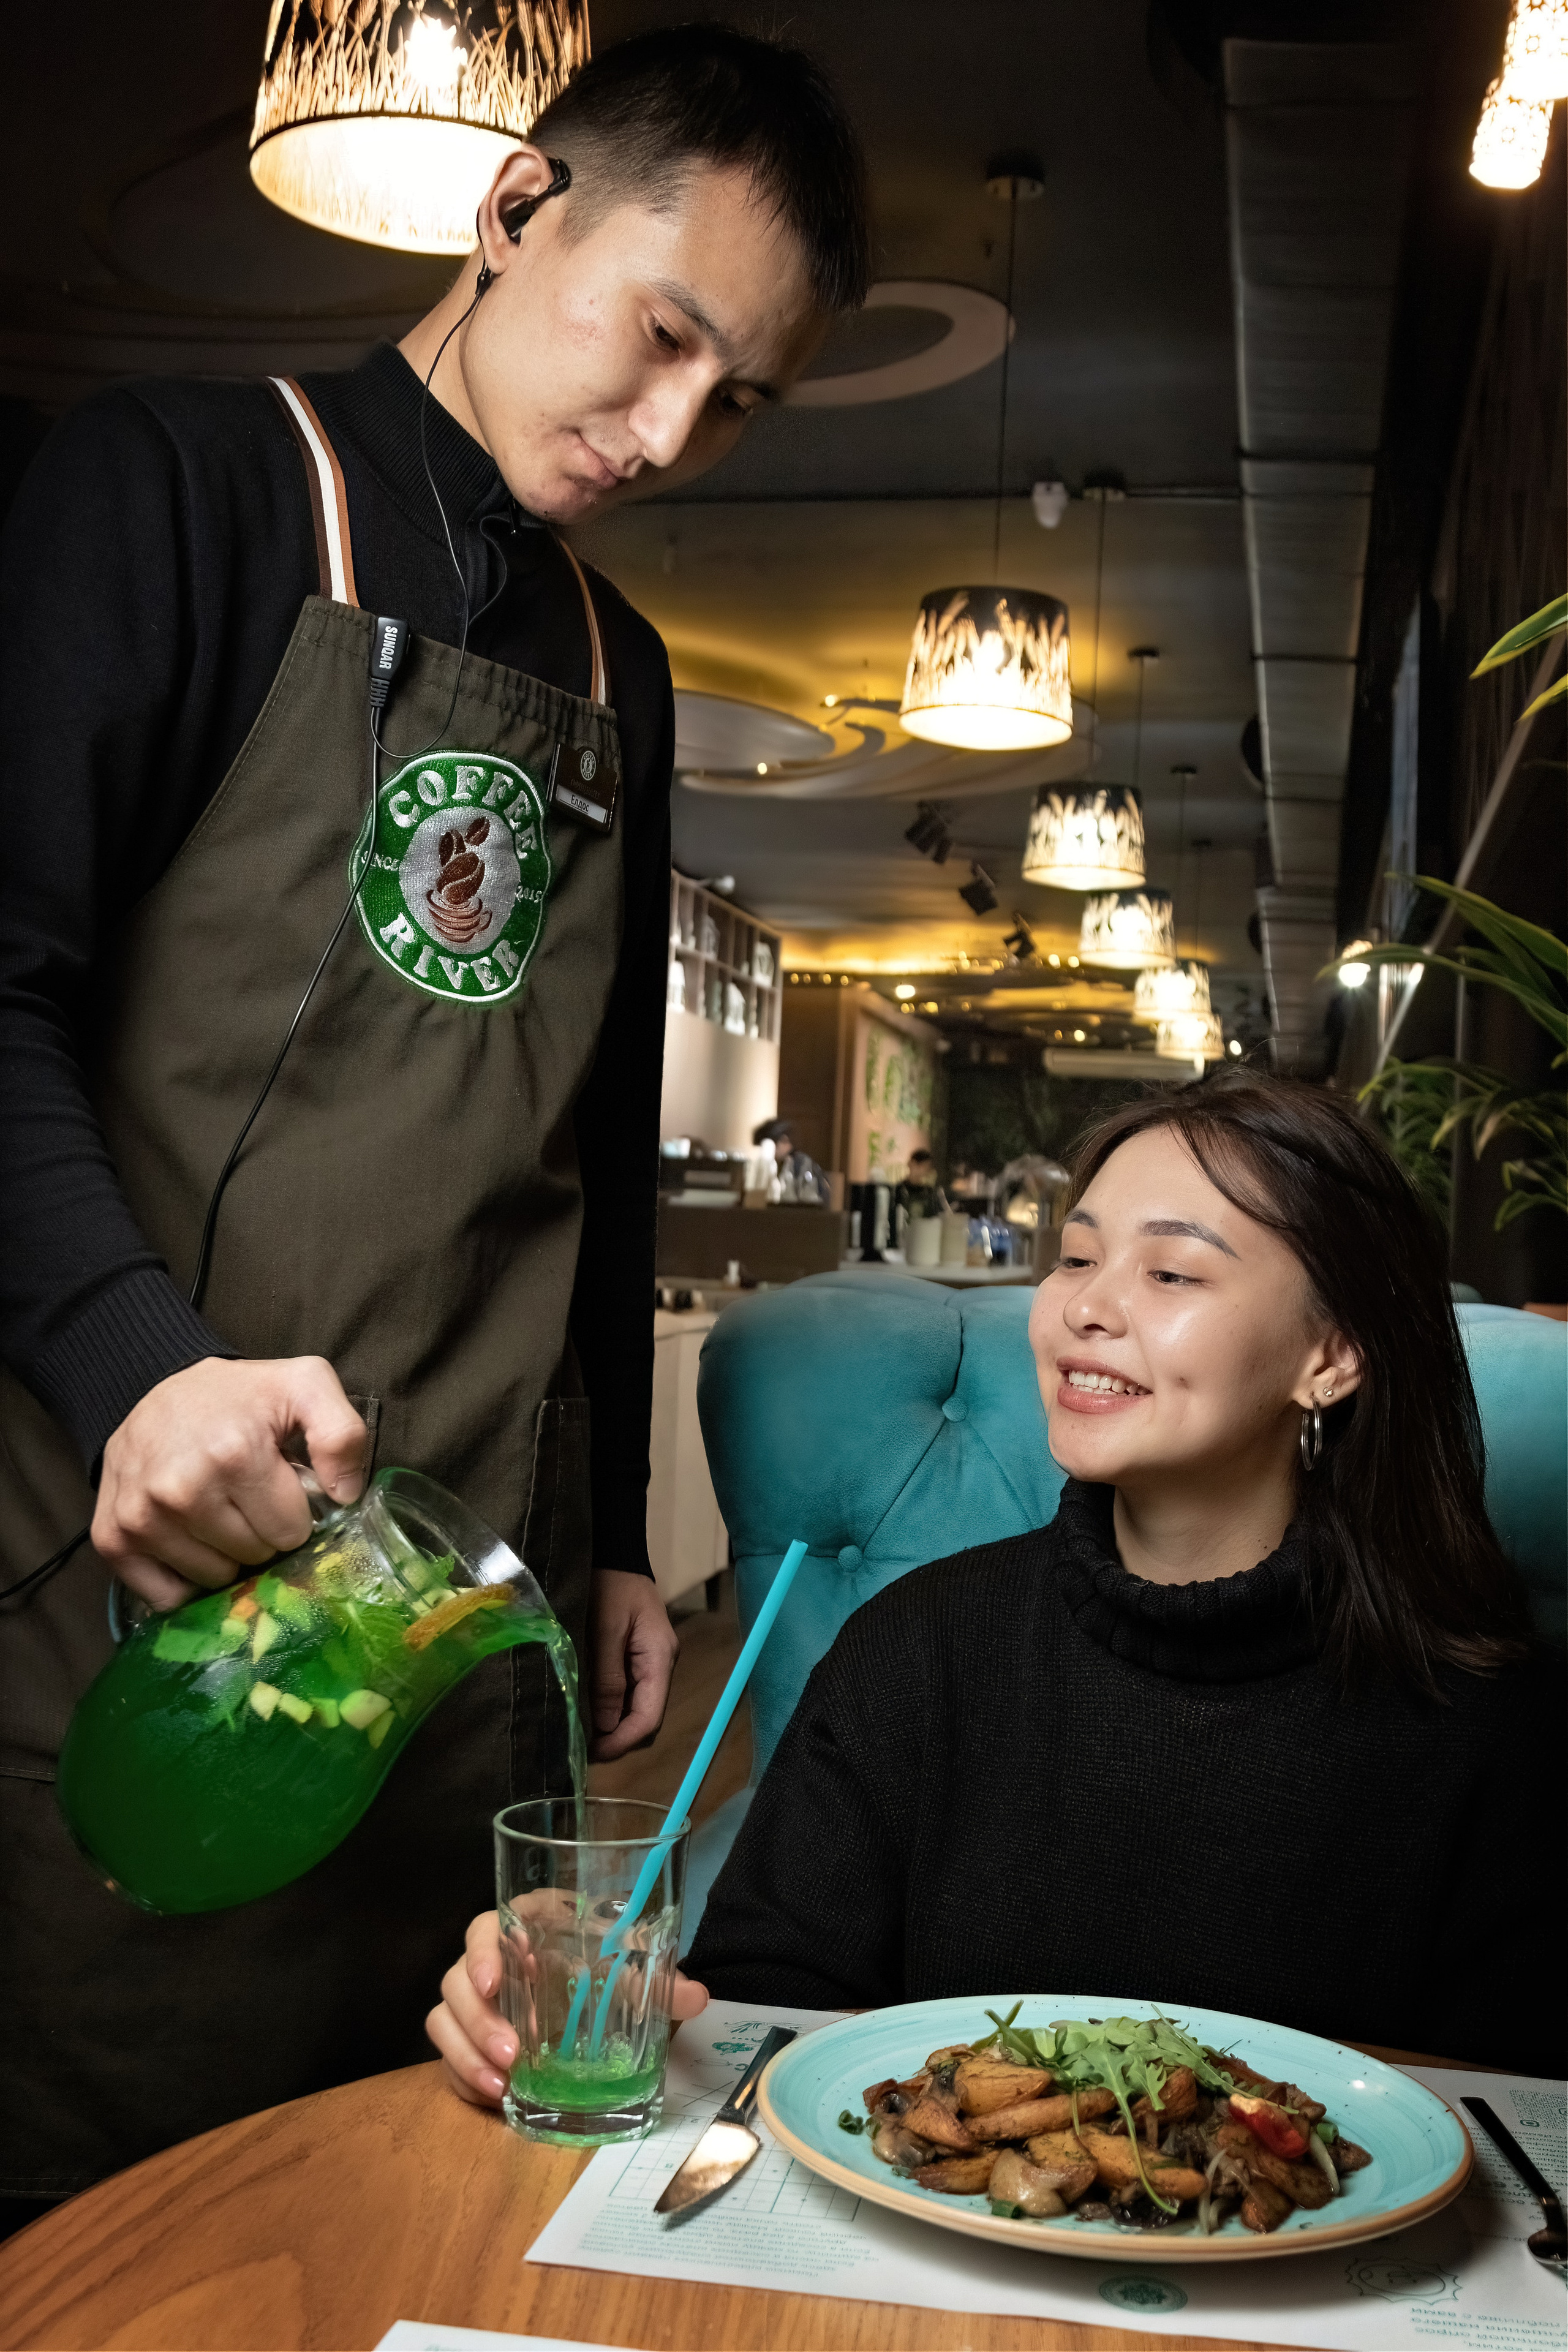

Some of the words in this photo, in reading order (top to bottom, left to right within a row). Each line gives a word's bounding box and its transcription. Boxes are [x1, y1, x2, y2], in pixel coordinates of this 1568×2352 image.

[379, 625, 398, 669] SUNQAR
[388, 765, 538, 859] COFFEE
[571, 794, 590, 812] Елдос
[361, 850, 400, 872] SNCE
[515, 885, 543, 903] 2015
[379, 912, 519, 992] RIVER
